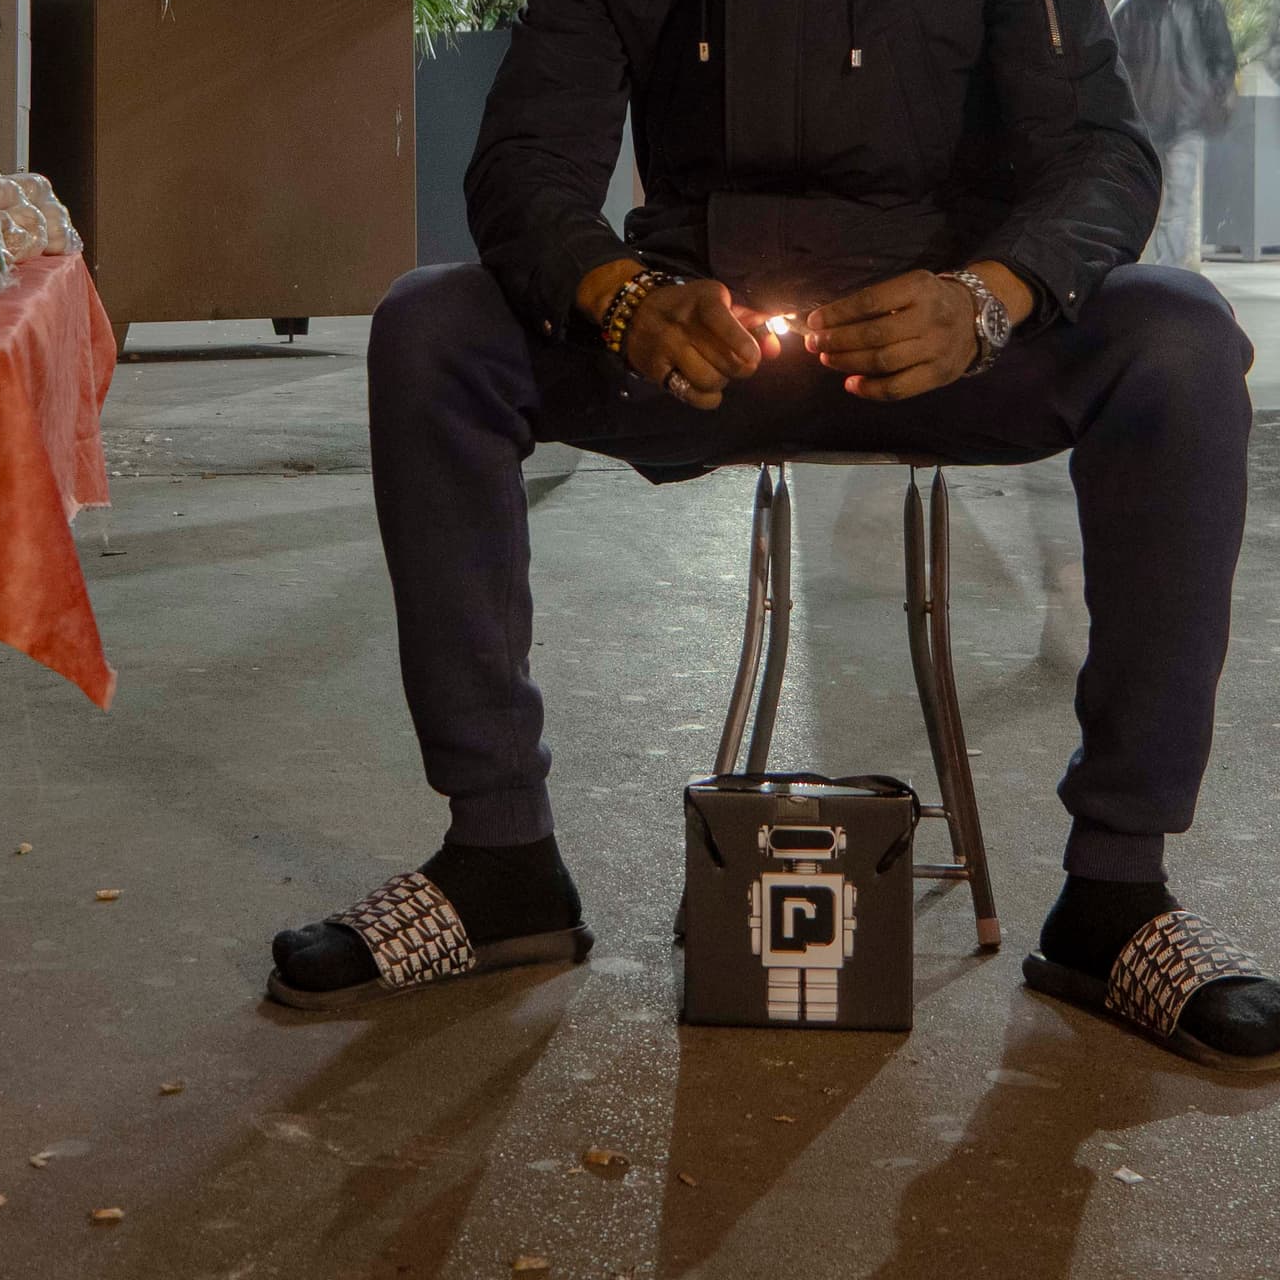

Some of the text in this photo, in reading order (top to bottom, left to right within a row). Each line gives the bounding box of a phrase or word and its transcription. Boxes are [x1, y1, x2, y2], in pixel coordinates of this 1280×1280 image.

[1156, 946, 1176, 965] NIKE
[1168, 960, 1188, 979] NIKE
[1180, 975, 1201, 995] NIKE
